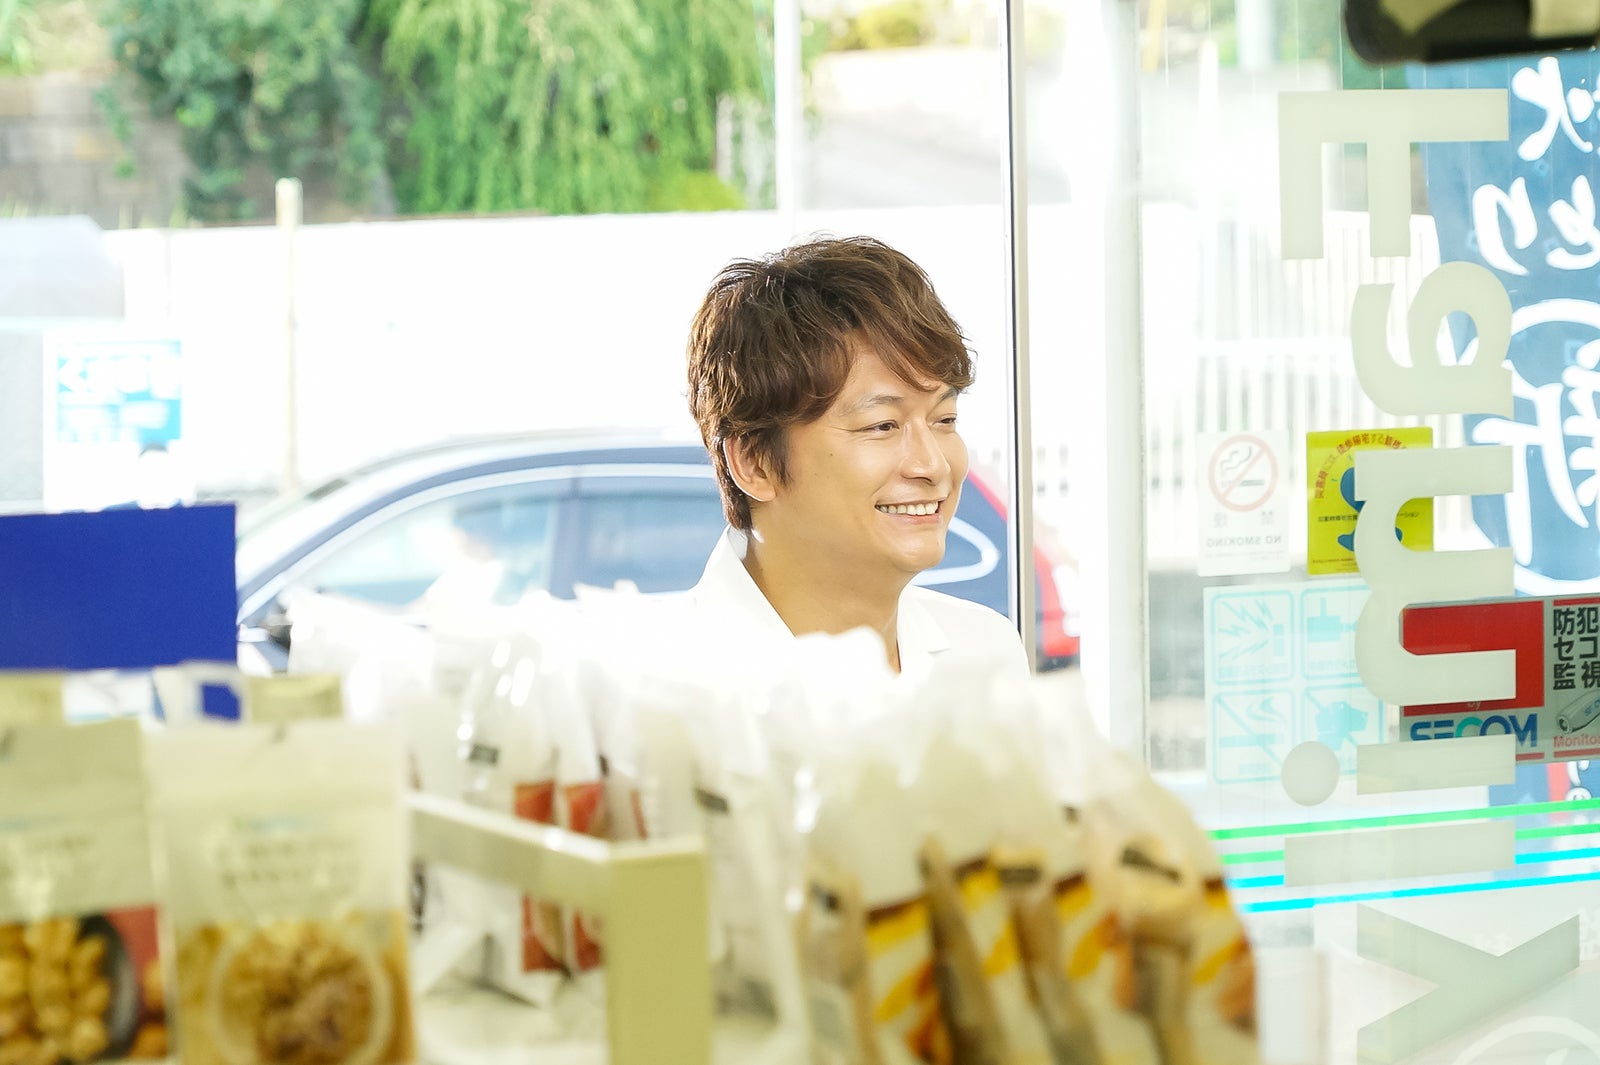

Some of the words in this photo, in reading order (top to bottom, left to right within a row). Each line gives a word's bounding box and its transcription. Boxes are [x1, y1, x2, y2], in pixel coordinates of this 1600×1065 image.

[1314, 432, 1407, 498] 災害時には、徒歩帰宅する皆様
[1553, 607, 1600, 636] 防犯
[1553, 636, 1600, 661] セコ
[1553, 661, 1600, 691] 監視
[1410, 713, 1538, 748] SECOM
[1553, 735, 1600, 748] Monito
